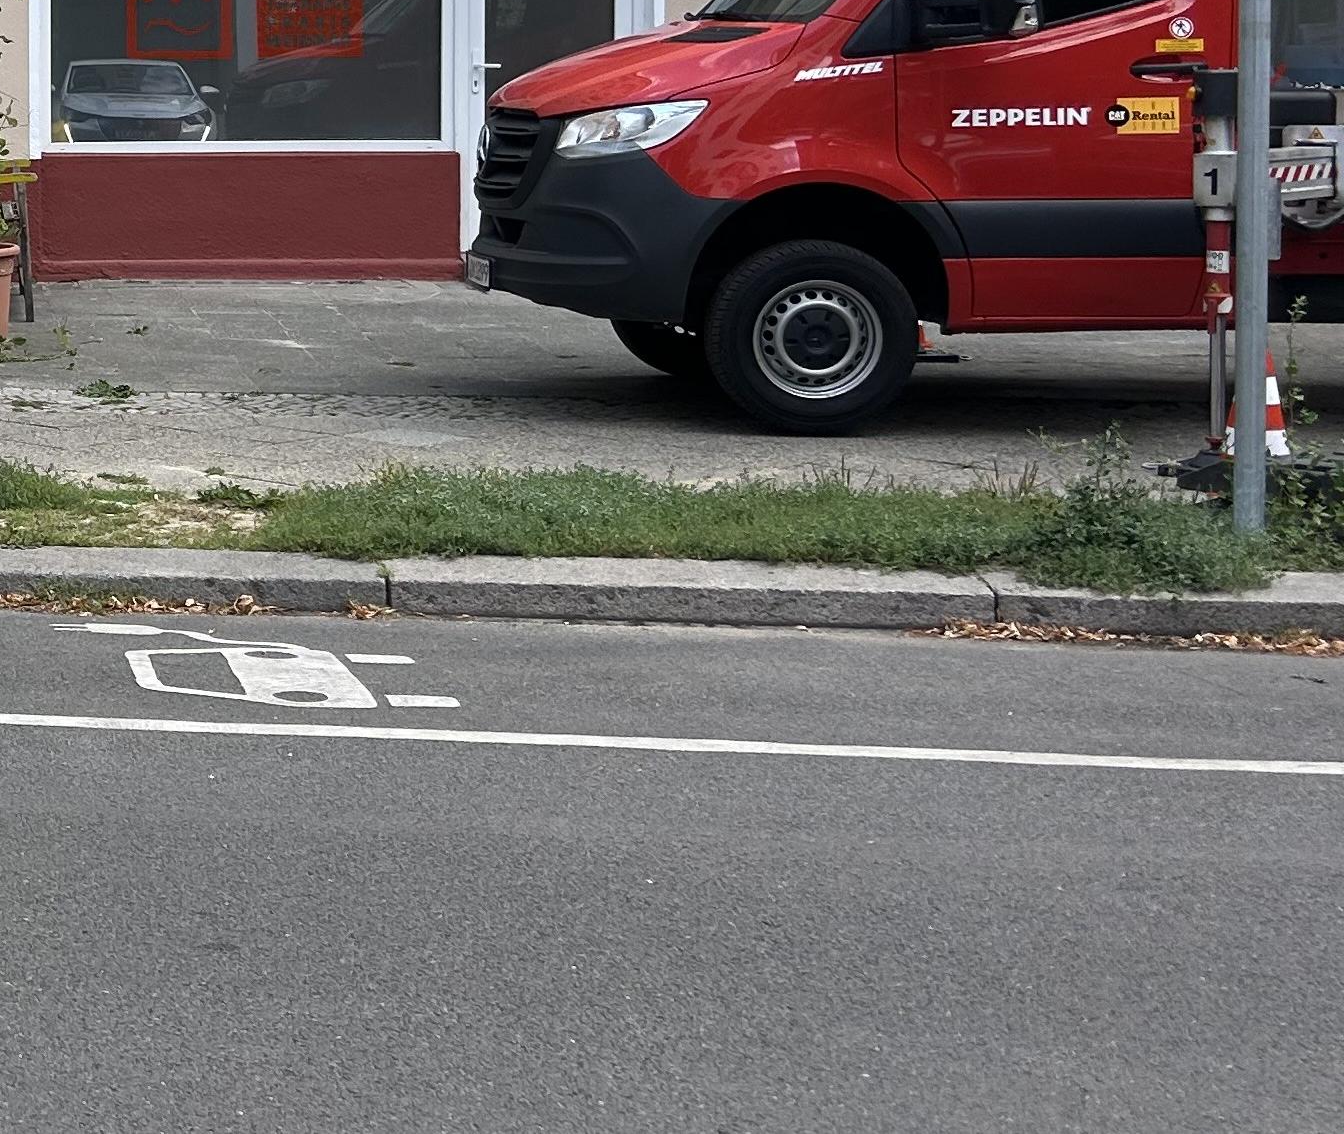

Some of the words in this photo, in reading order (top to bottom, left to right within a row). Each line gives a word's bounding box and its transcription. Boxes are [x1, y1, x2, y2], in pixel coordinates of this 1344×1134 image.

[793, 61, 884, 82] MULTITEL
[950, 107, 1089, 127] ZEPPELIN
[1108, 110, 1126, 121] CAT
[1131, 110, 1176, 121] Rental
[1204, 168, 1219, 196] 1
